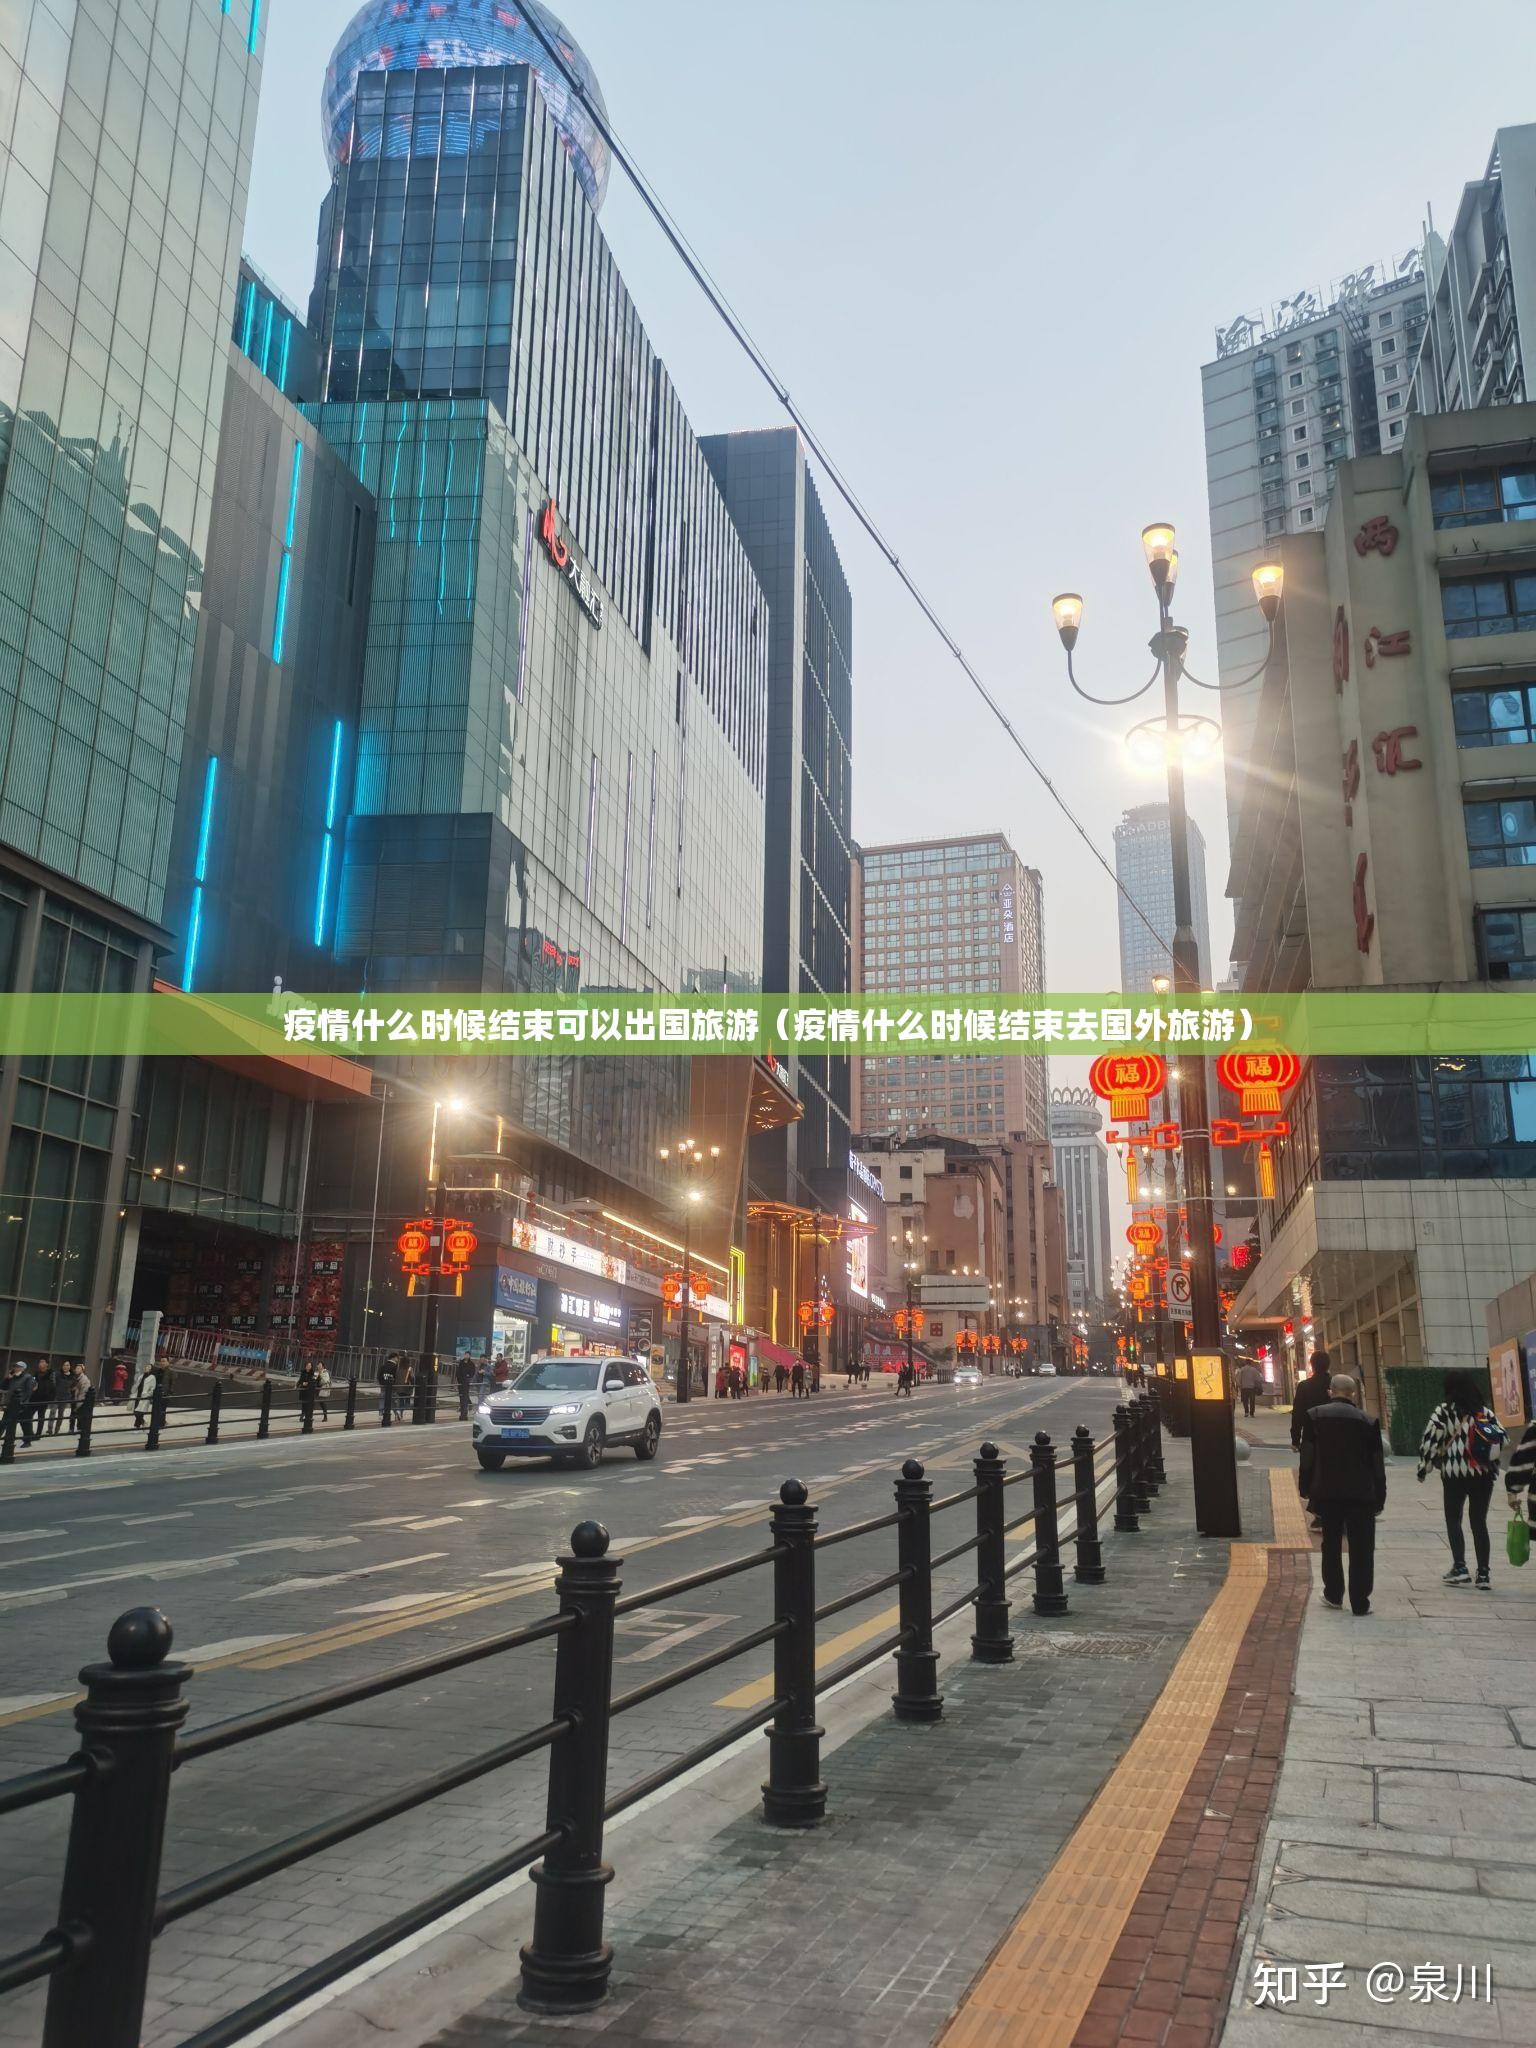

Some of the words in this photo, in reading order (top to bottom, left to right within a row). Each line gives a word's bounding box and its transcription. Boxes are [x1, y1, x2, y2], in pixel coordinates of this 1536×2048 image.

[1003, 898, 1014, 943] 亚朵酒店
[1115, 1063, 1140, 1084] 福
[1246, 1056, 1272, 1077] 福
